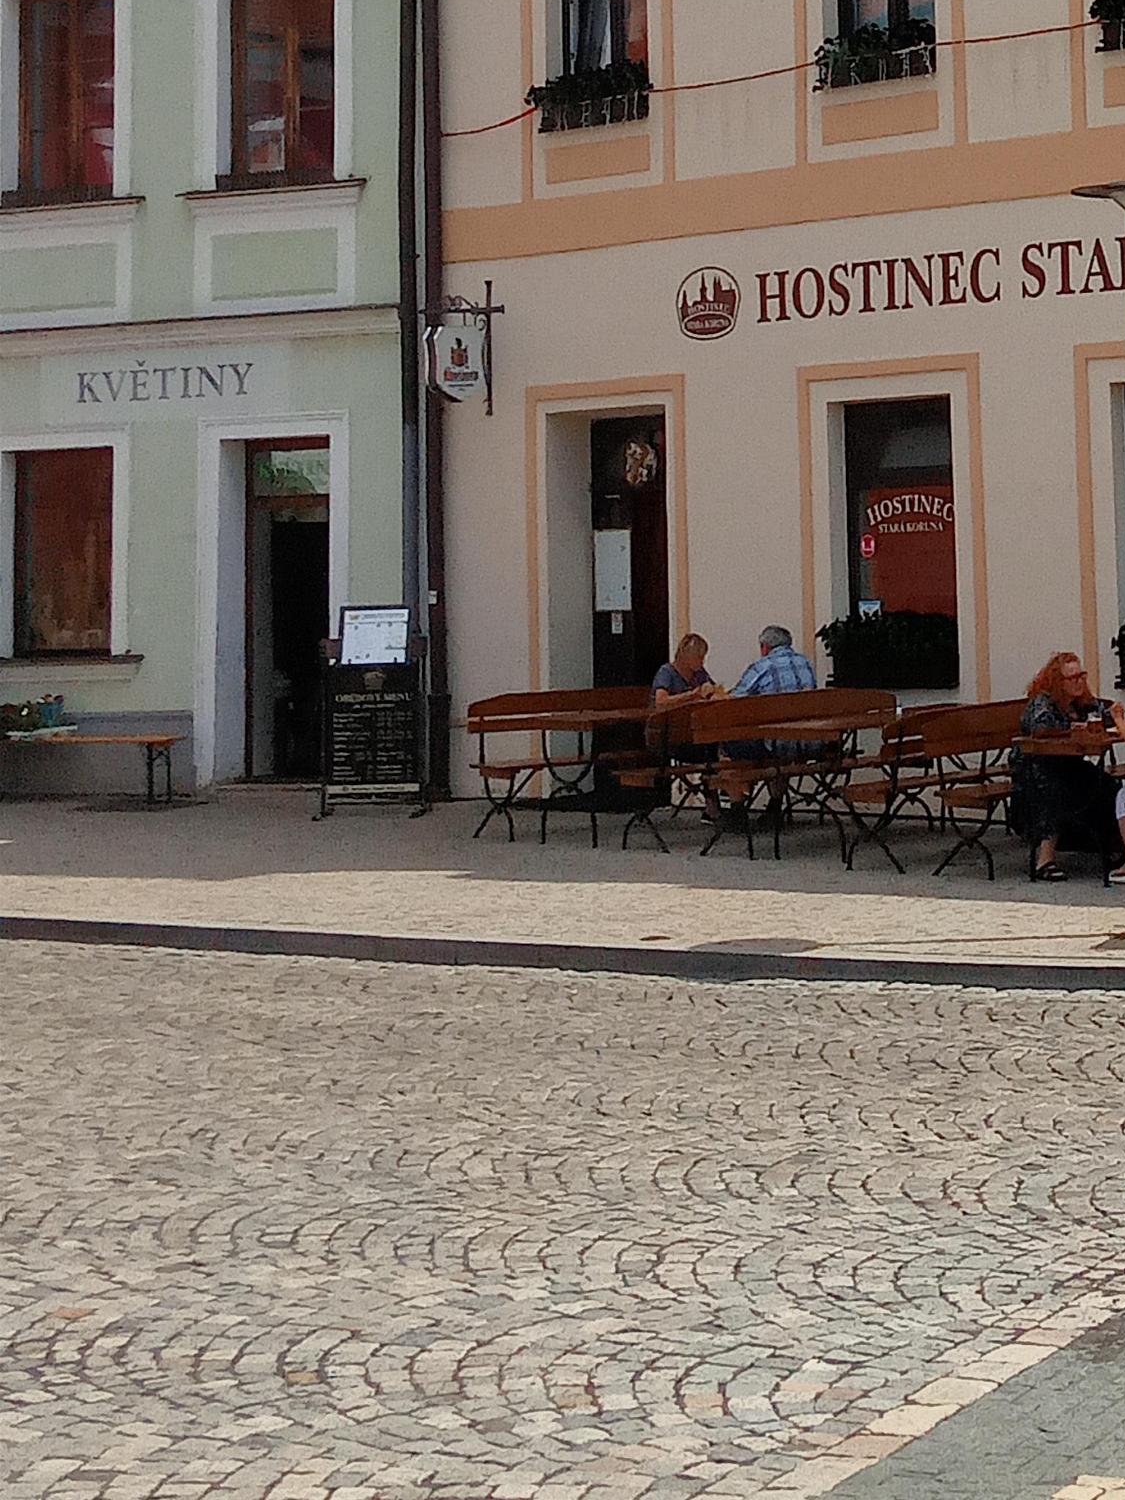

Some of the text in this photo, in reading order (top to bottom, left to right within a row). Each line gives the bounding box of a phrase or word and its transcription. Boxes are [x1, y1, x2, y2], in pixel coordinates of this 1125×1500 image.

[755, 248, 1001, 323] HOSTINEC
[77, 359, 254, 403] KVĚTINY
[867, 494, 954, 526] HOSTINEC
[906, 521, 944, 533] KORUNA
